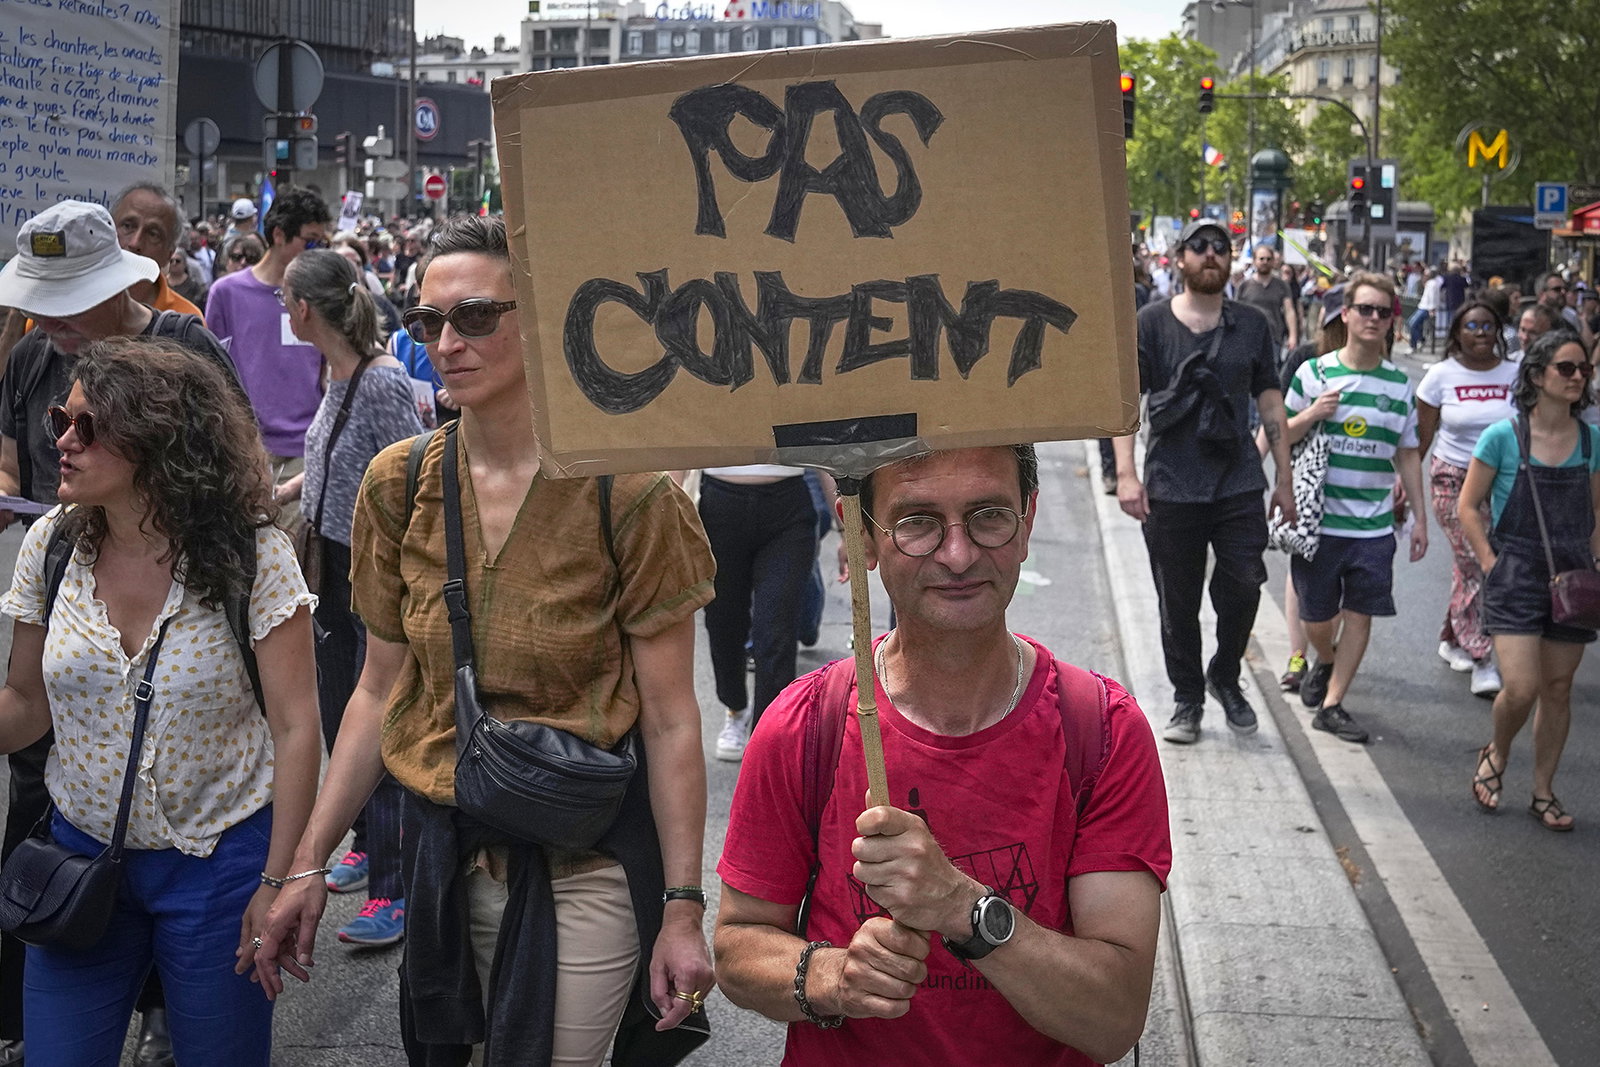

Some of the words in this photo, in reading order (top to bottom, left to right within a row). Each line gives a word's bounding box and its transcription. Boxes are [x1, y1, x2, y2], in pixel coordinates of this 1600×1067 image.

[655, 1, 714, 21] Crédit
[752, 0, 821, 19] Mutuel
[20, 26, 37, 47] les
[104, 41, 118, 57] les
[109, 67, 121, 80] de
[108, 86, 159, 108] diminue
[16, 95, 28, 109] de
[33, 101, 67, 119] jours
[122, 110, 155, 126] durée
[78, 128, 101, 145] pas
[109, 127, 139, 145] chier
[144, 133, 153, 146] si
[38, 139, 71, 160] qu'on
[76, 147, 101, 159] nous
[107, 149, 157, 167] marche
[1468, 129, 1509, 169] M
[16, 161, 69, 183] gueule
[668, 80, 945, 243] PAS
[36, 182, 47, 201] le
[1544, 189, 1560, 210] P
[564, 268, 1079, 415] CONTENT
[1330, 436, 1376, 454] afabet
